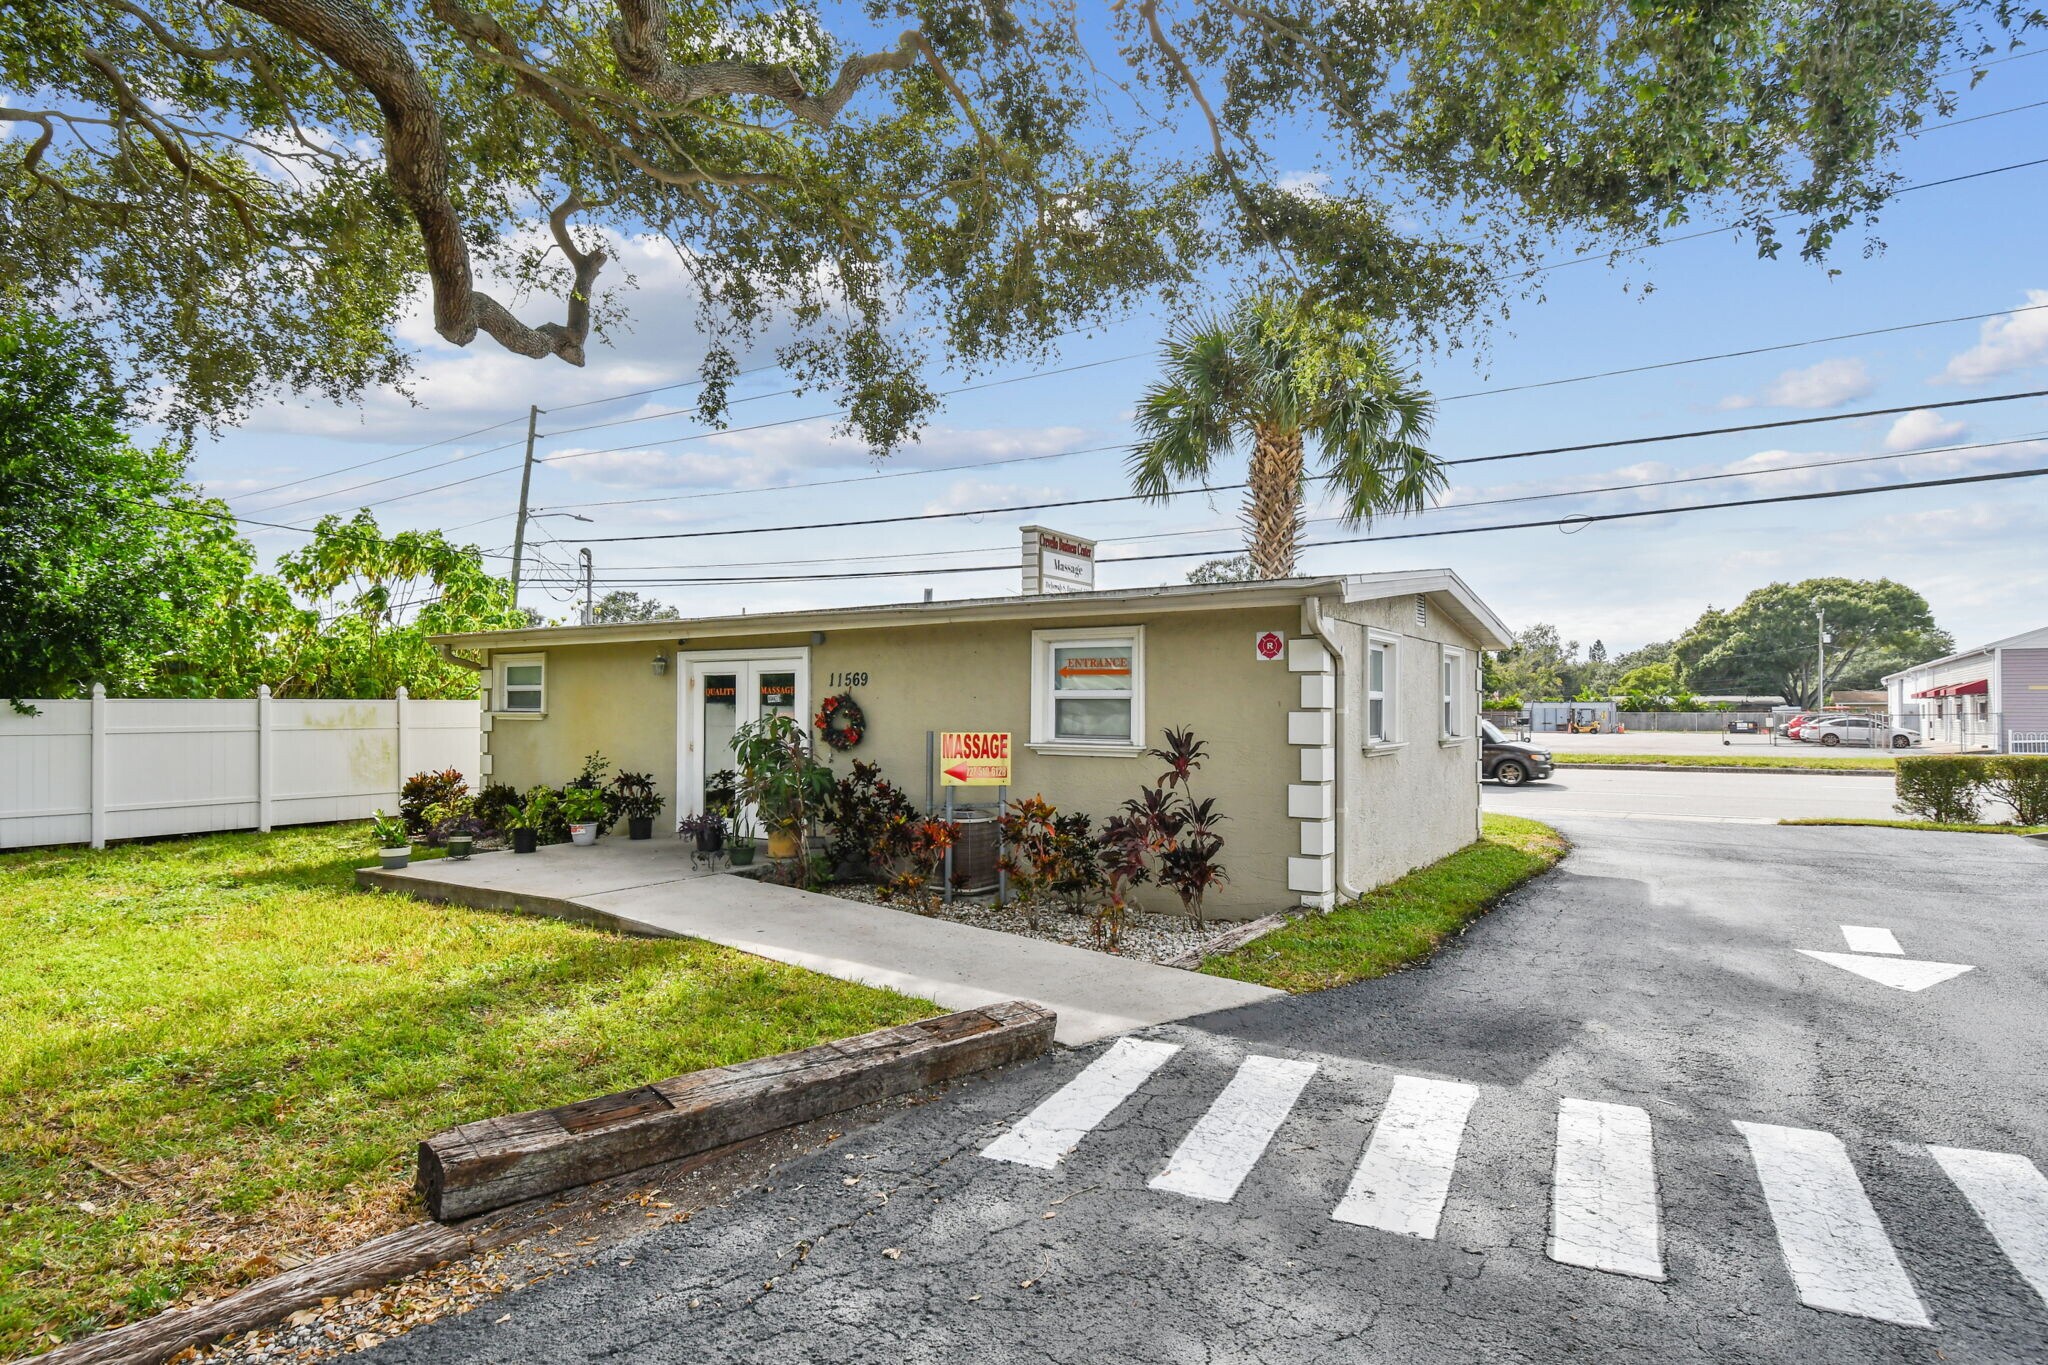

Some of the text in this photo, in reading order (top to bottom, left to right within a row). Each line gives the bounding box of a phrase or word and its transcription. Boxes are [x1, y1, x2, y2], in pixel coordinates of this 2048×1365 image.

[1078, 542, 1092, 558] Center
[1054, 558, 1083, 577] Massage
[1266, 642, 1274, 650] R
[1067, 657, 1128, 668] ENTRANCE
[829, 671, 869, 687] 11569
[705, 687, 736, 697] QUALITY
[760, 686, 796, 695] MASSAGE
[942, 733, 1008, 759] MASSAGE
